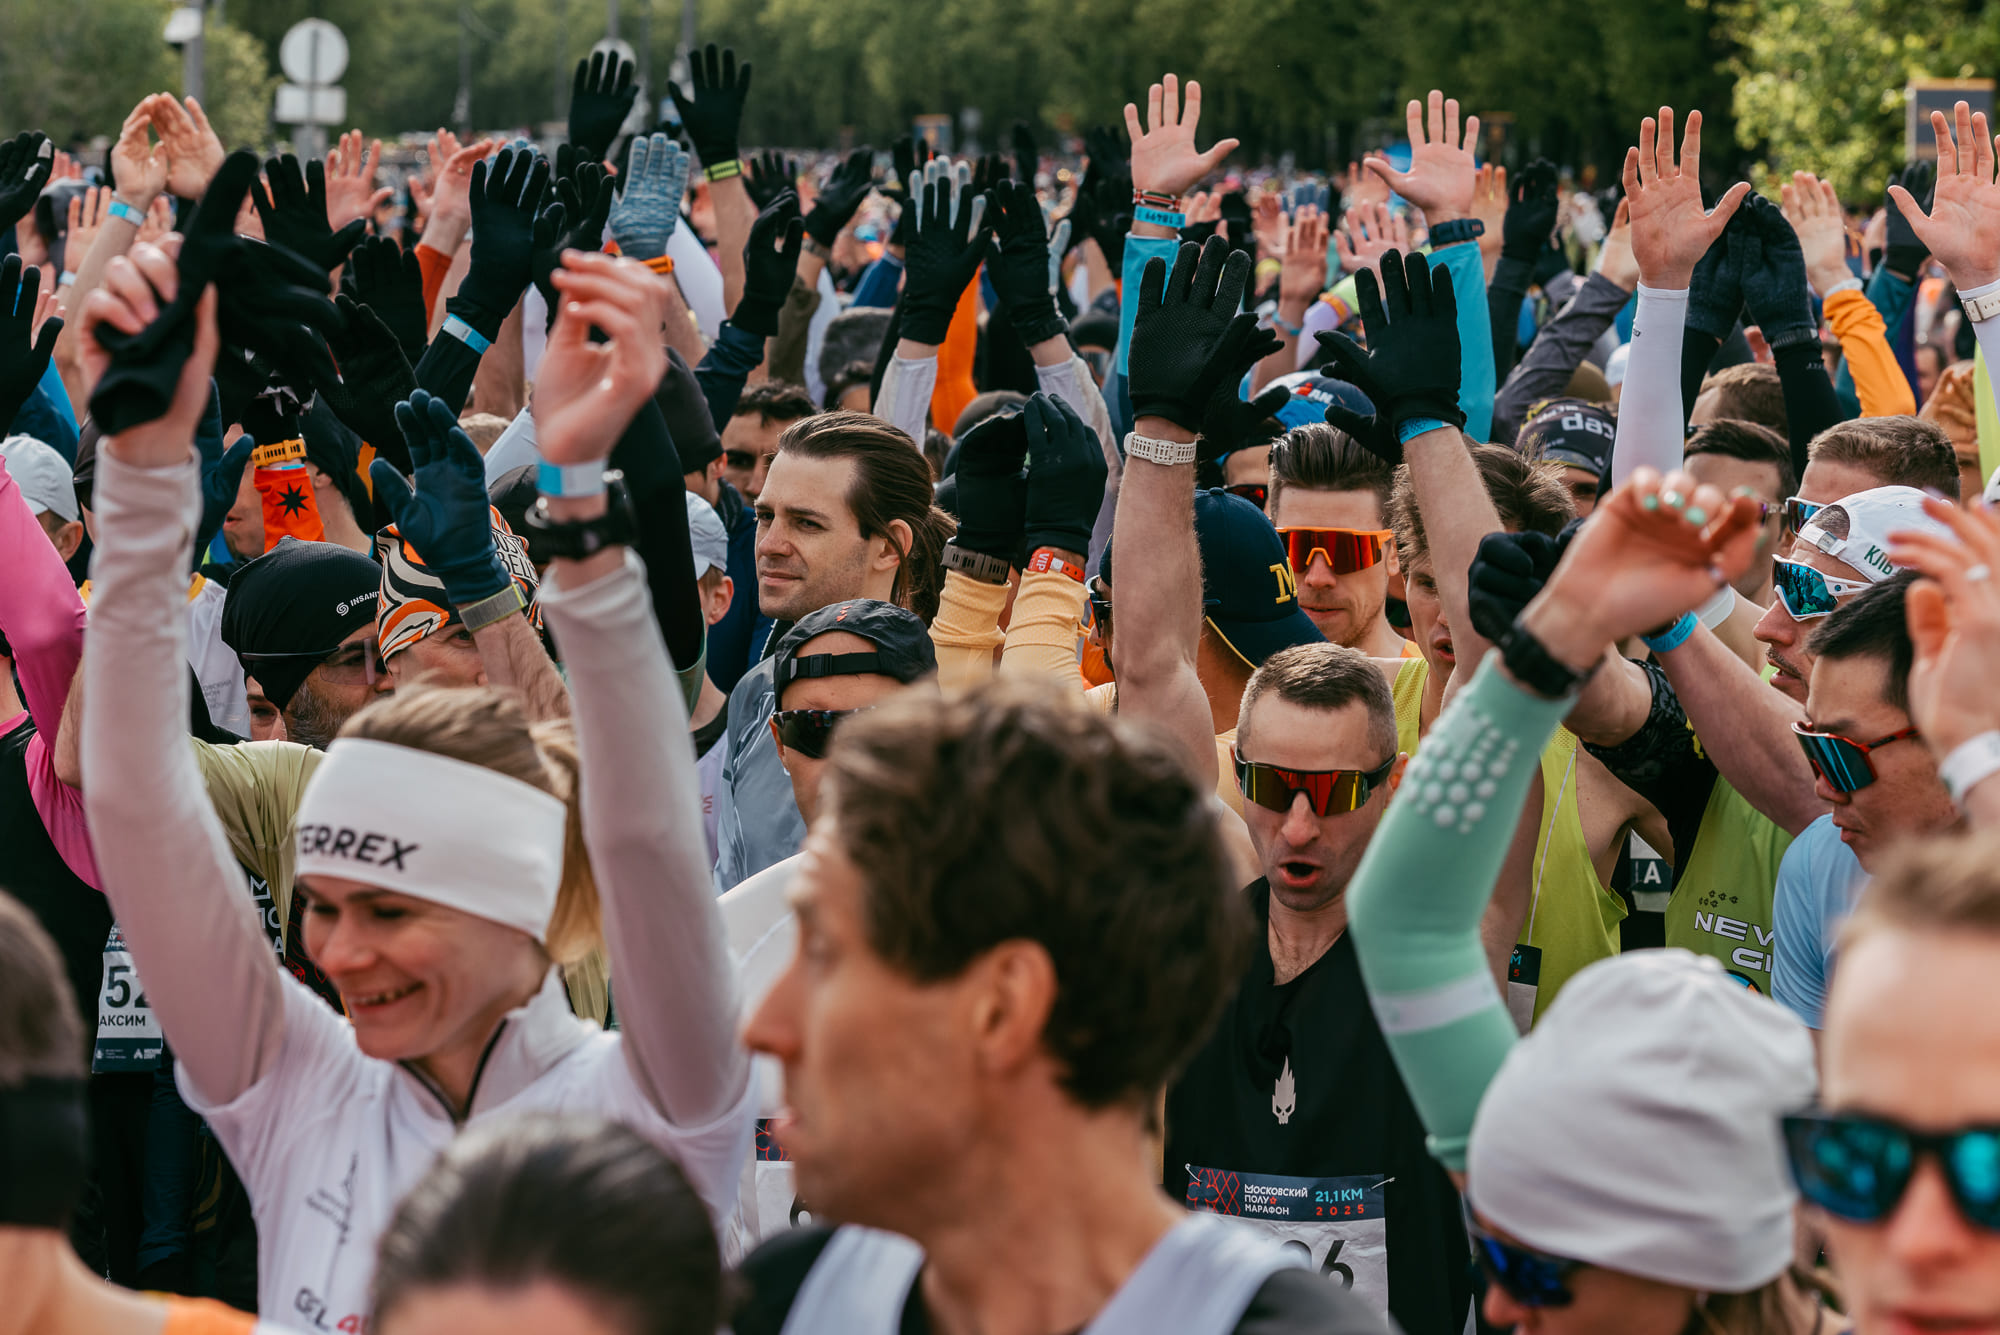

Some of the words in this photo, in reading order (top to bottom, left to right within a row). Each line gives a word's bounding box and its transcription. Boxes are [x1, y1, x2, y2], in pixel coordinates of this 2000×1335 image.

[1036, 552, 1050, 571] VIP
[1269, 556, 1298, 604] M
[1643, 860, 1662, 884] A
[1244, 1195, 1270, 1204] ПОЛУ
[1244, 1204, 1289, 1215] МАРАФОН
